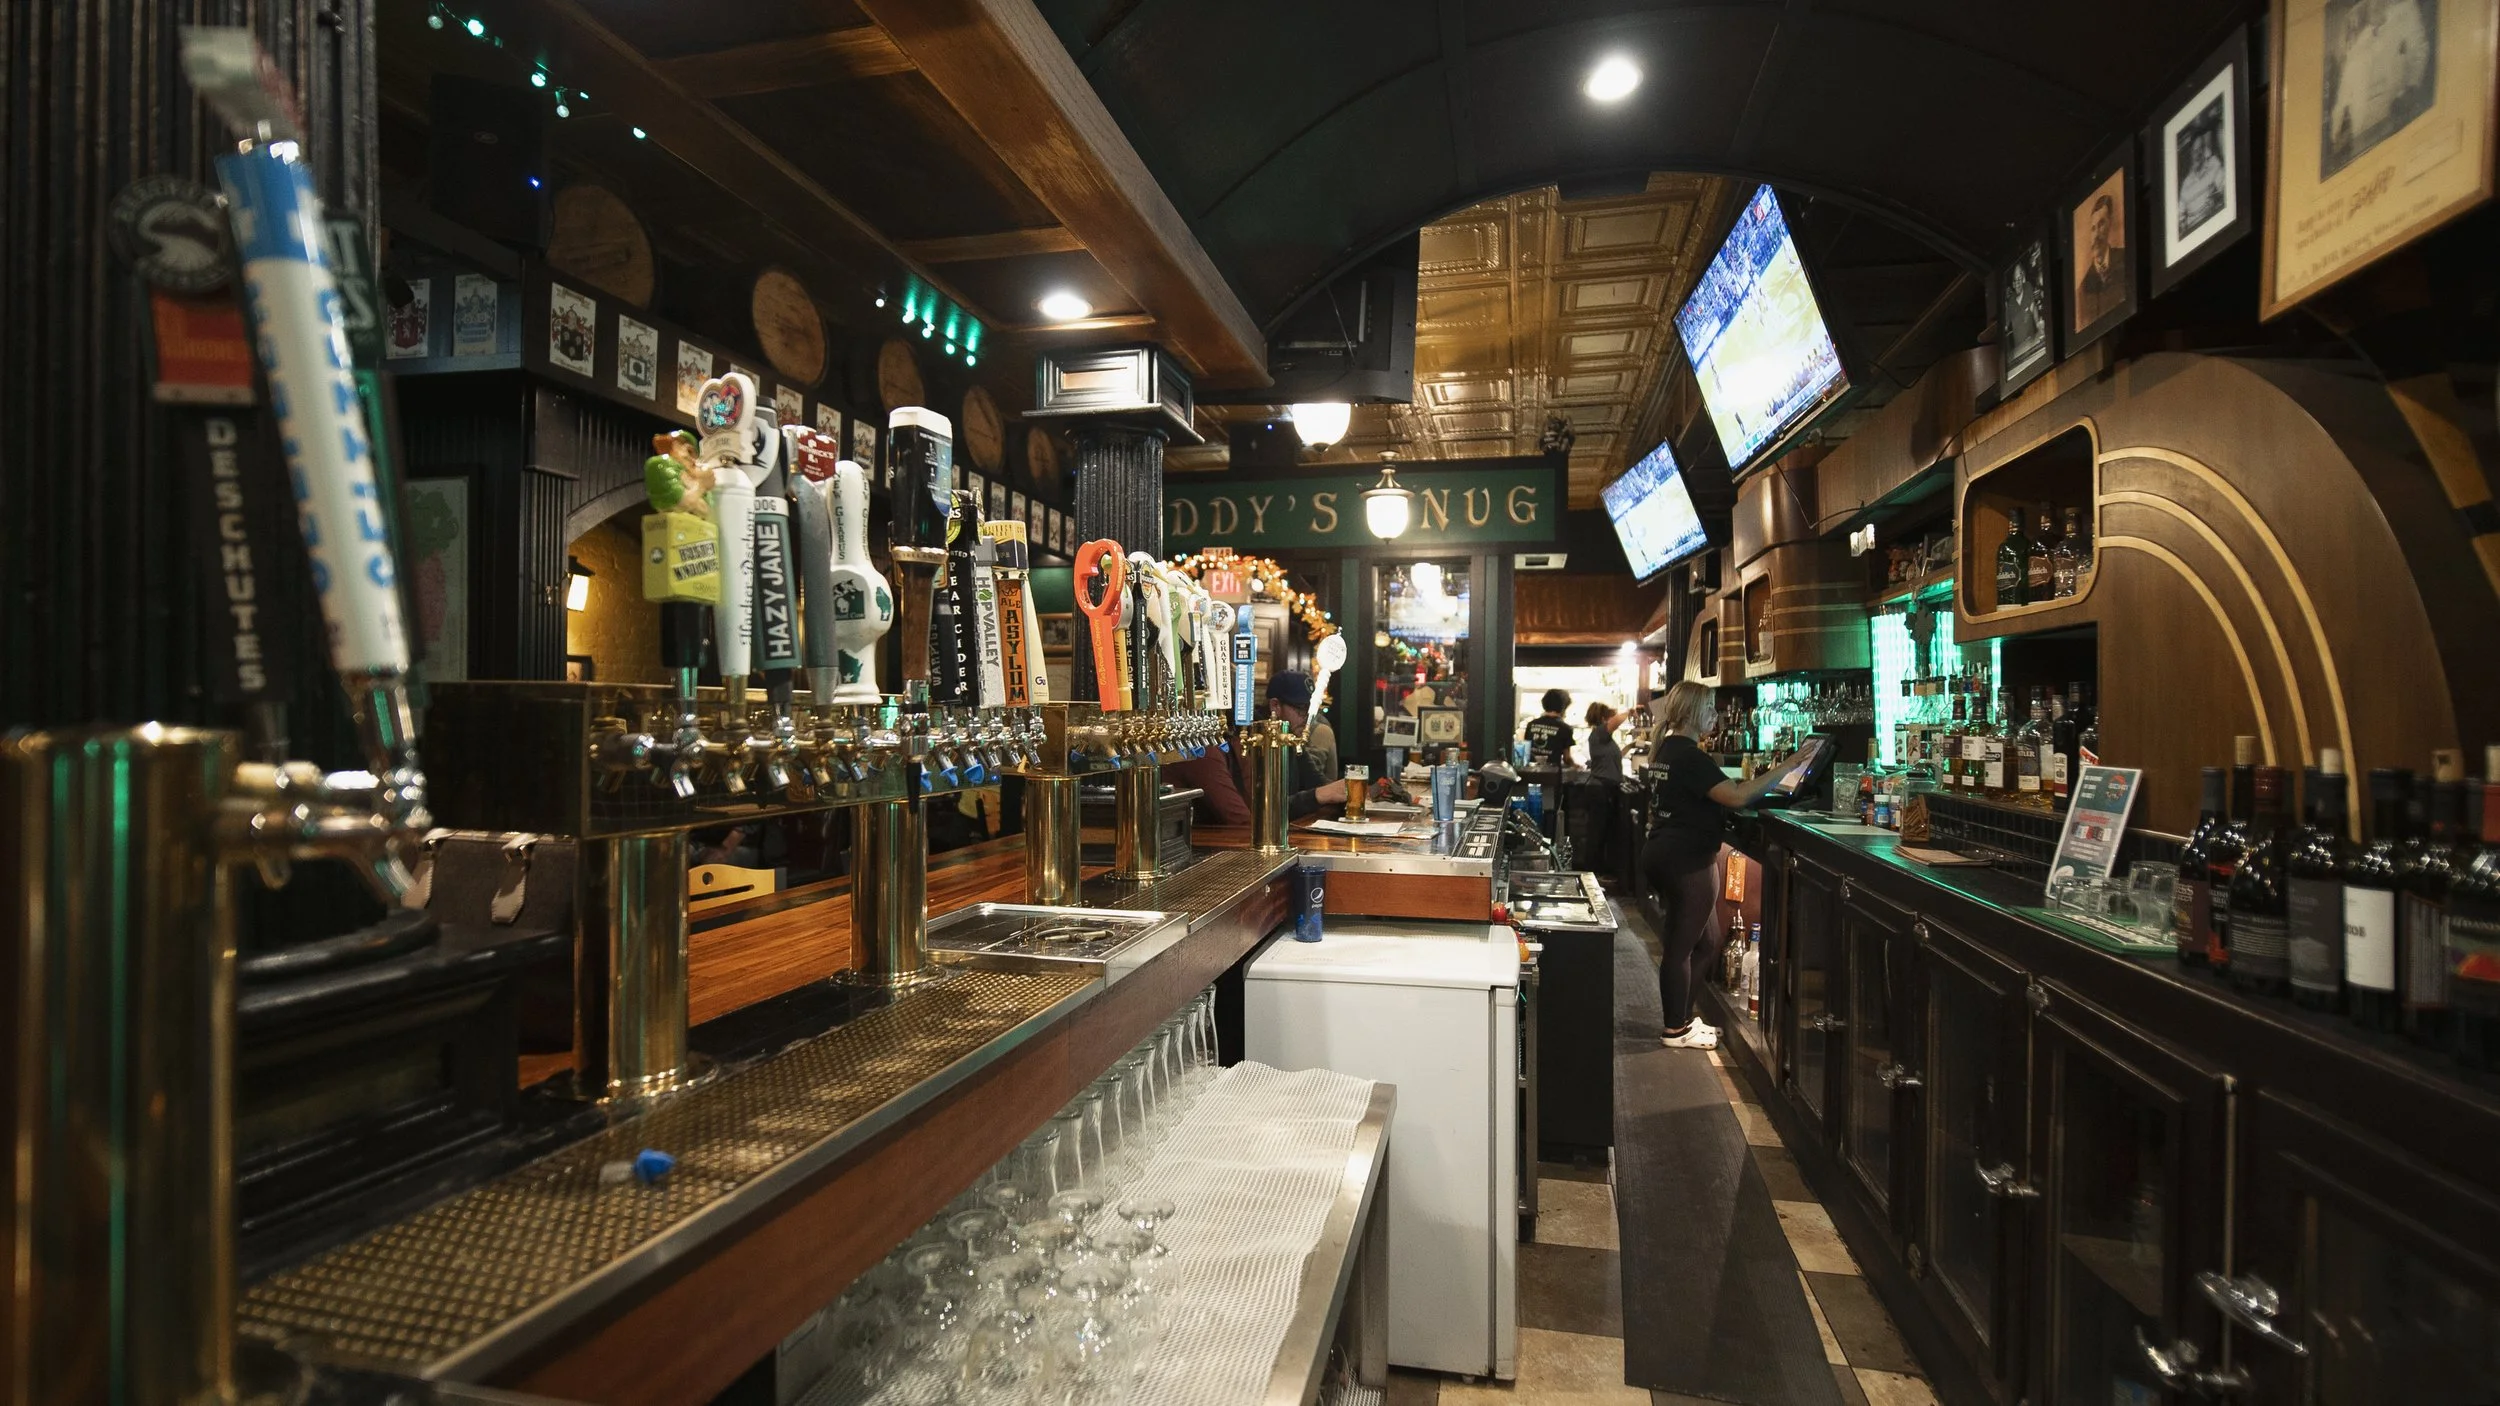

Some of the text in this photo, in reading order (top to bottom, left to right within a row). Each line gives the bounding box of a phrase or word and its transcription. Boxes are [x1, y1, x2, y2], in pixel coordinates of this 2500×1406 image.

[1168, 484, 1541, 538] DDY'S NUG
[206, 418, 266, 690] DESCHUTES
[757, 523, 793, 658] HAZY JANE
[1000, 597, 1022, 609] ALE
[1212, 571, 1242, 594] EXIT
[949, 562, 968, 692] PEAR CIDER
[1004, 609, 1026, 701] ASYLUM
[1126, 651, 1134, 690] CIDER
[1219, 639, 1229, 707] GRAY BREWING
[1238, 663, 1249, 691] GRAIN
[1236, 691, 1247, 722] RAISED
